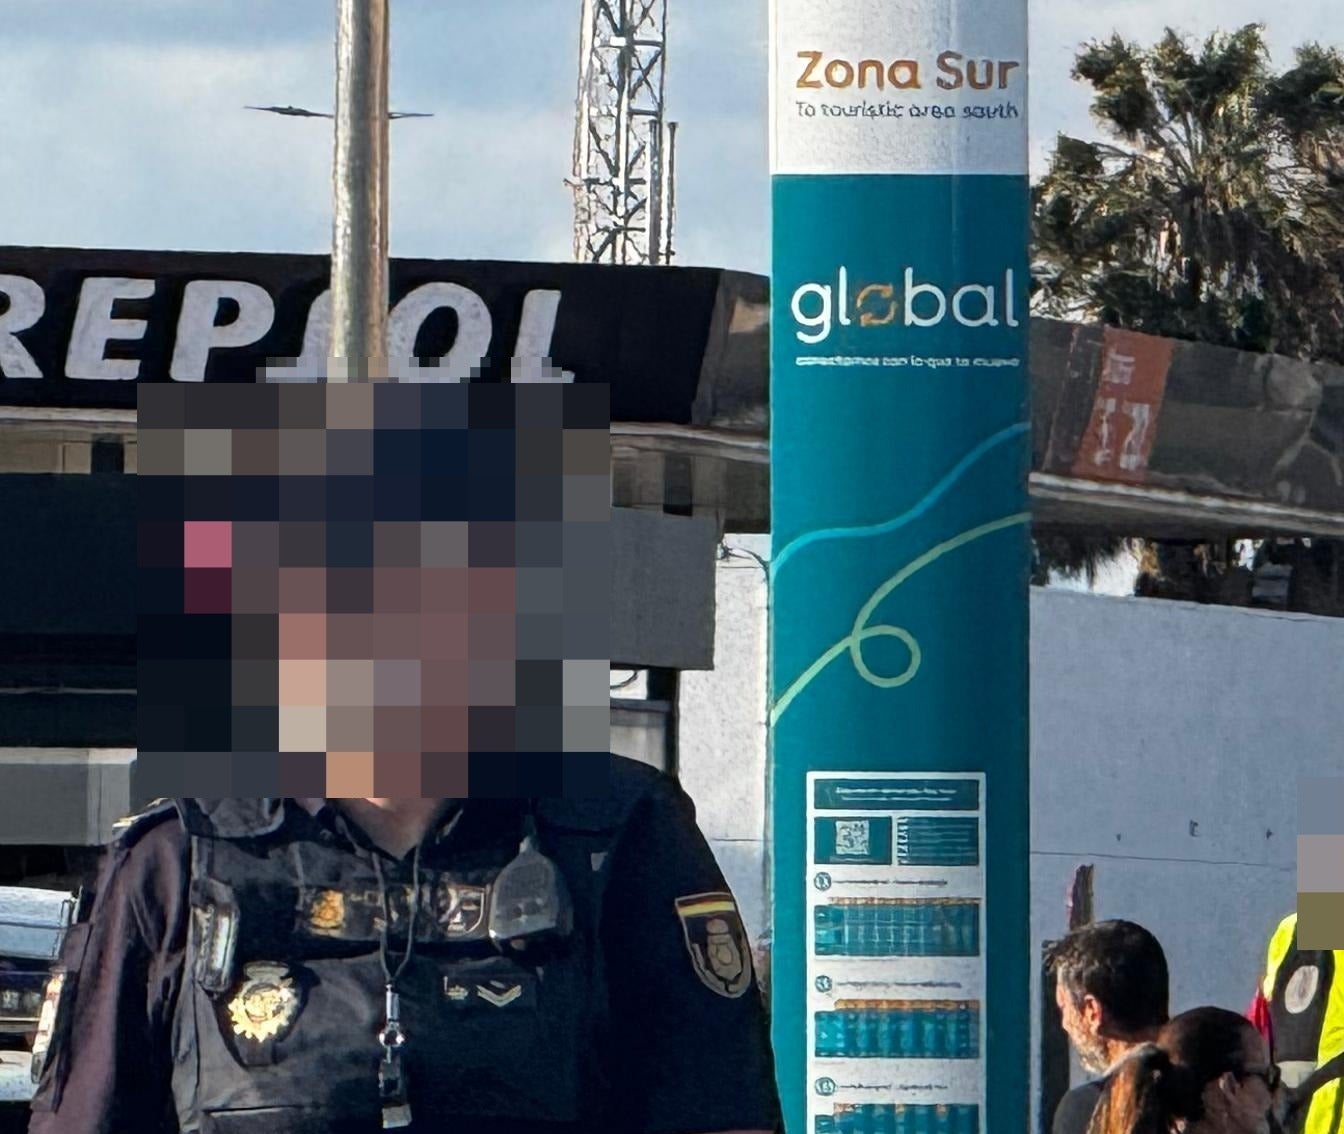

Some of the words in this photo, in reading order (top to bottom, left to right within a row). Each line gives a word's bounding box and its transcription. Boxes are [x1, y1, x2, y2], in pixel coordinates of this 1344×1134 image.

[796, 50, 922, 91] Zona
[936, 50, 1019, 90] Sur
[796, 102, 815, 117] To
[791, 266, 1019, 344] global
